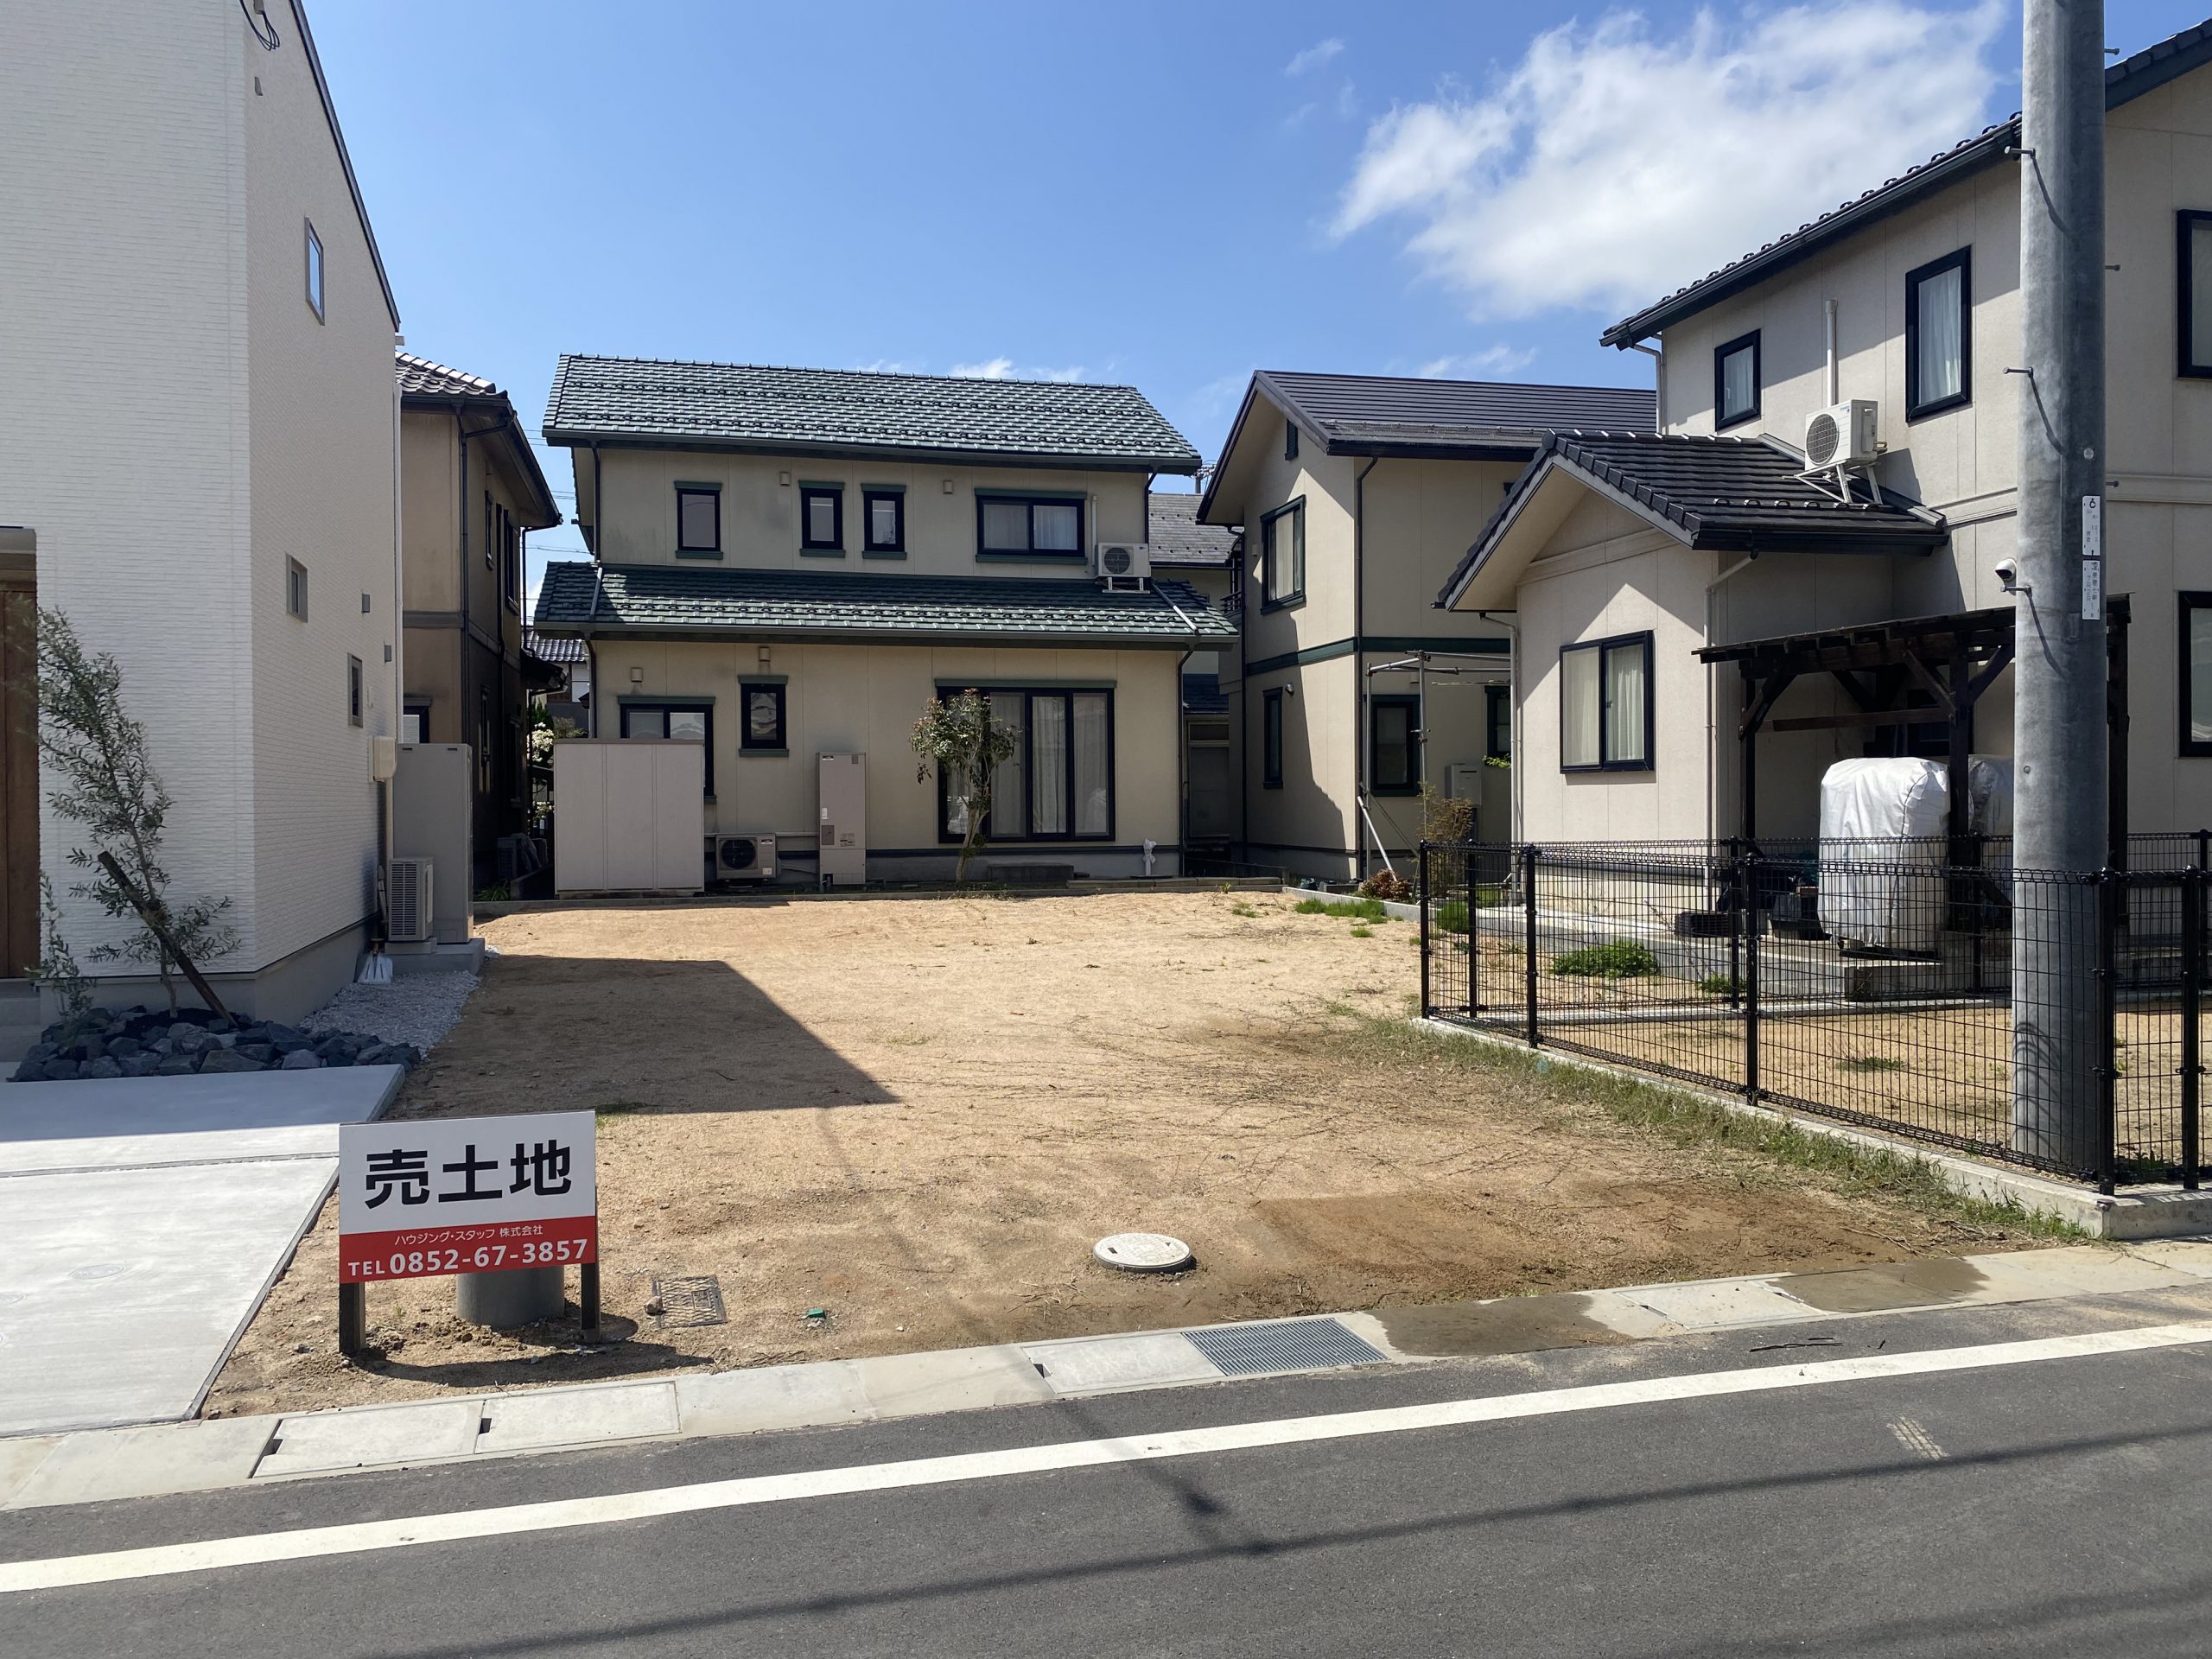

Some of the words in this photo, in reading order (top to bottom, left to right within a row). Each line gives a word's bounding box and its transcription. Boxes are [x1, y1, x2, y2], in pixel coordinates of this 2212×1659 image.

[365, 1139, 572, 1210] 売土地
[394, 1229, 495, 1246] ハウジング・スタッフ
[499, 1224, 543, 1237] 株式会社
[347, 1261, 385, 1276] TEL
[389, 1238, 588, 1274] 0852-67-3857
